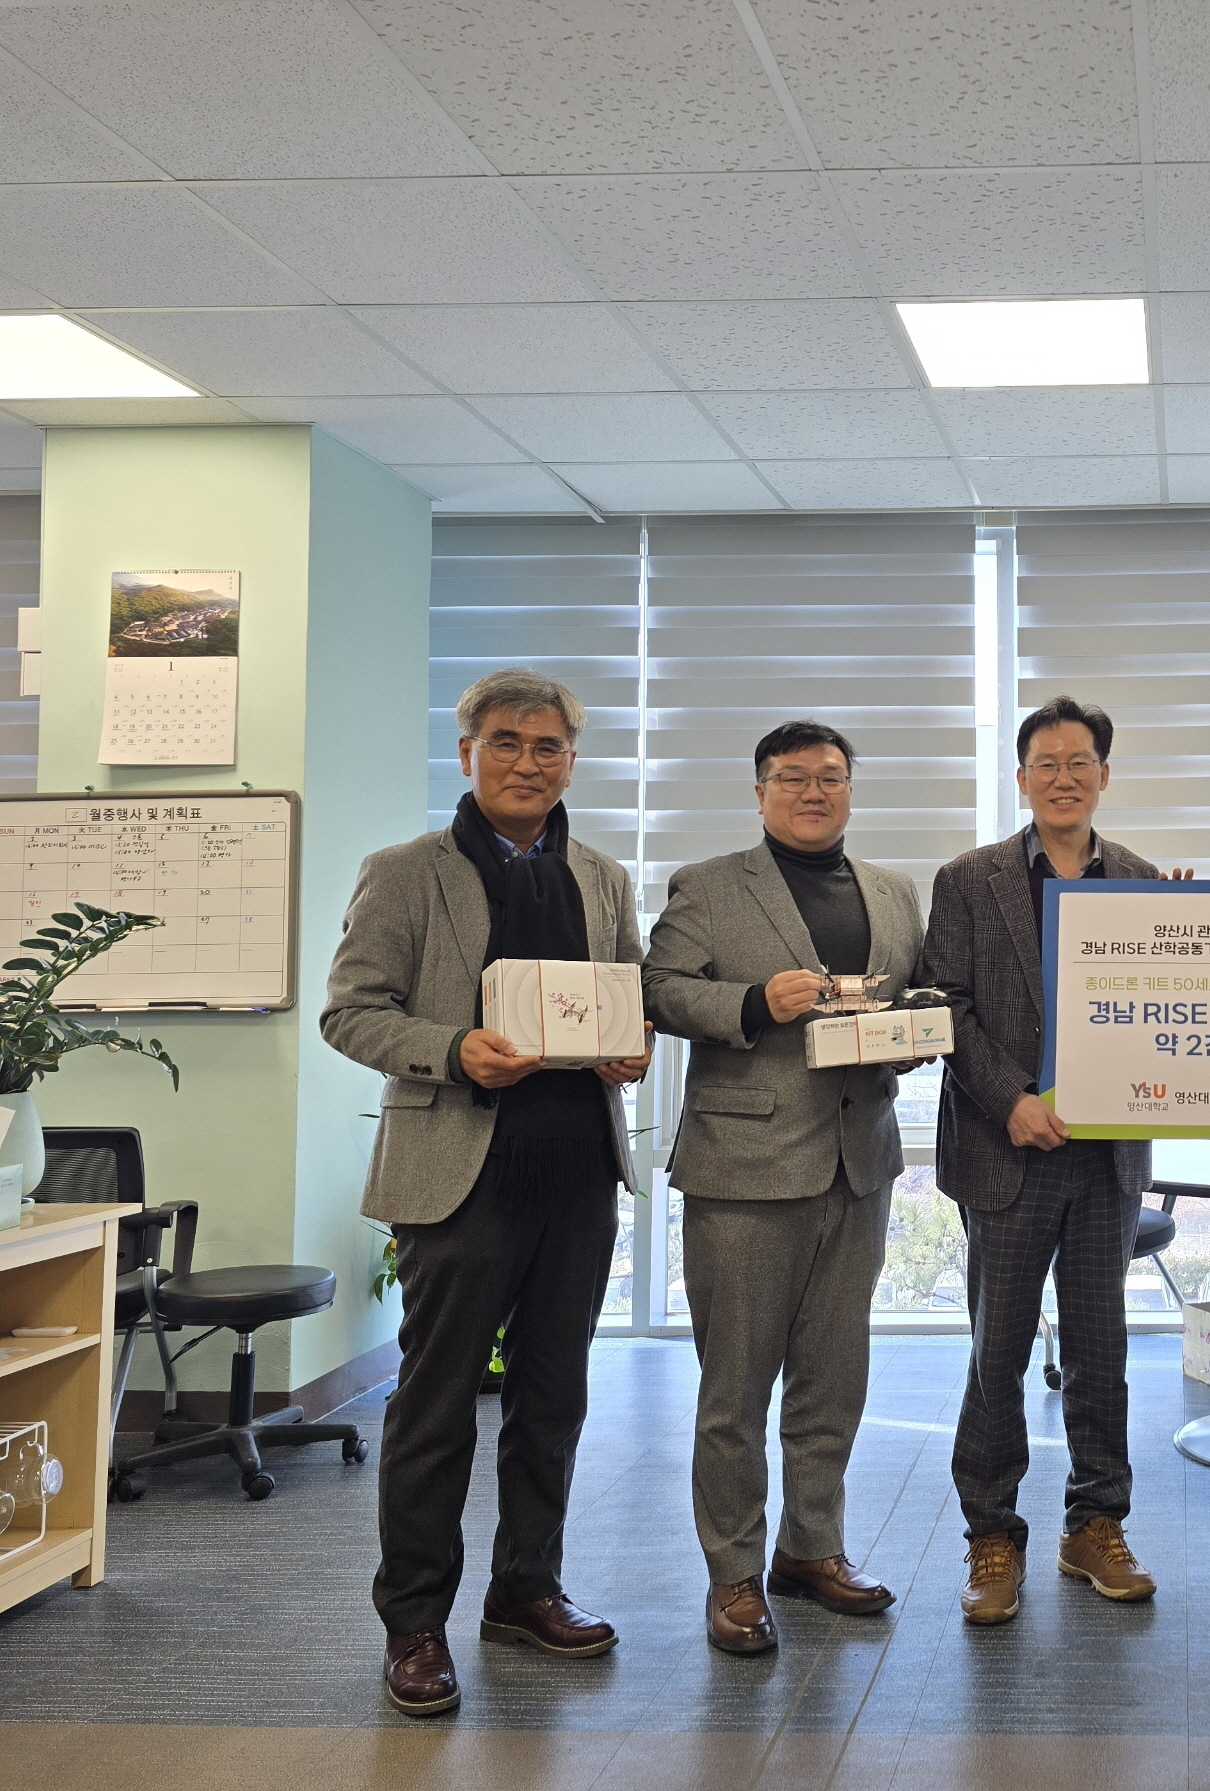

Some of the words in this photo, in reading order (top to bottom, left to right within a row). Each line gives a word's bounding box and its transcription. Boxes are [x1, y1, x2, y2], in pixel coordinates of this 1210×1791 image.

[89, 807, 142, 822] 월중행사
[147, 807, 158, 821] 및
[162, 806, 203, 820] 계획표
[1154, 925, 1193, 937] 양산시
[1081, 942, 1107, 954] 경남
[1111, 943, 1146, 954] RISE
[1085, 977, 1138, 990] 종이드론
[1143, 977, 1169, 990] 키트
[1089, 1001, 1135, 1024] 경남
[1144, 1003, 1207, 1024] RISE
[1155, 1033, 1178, 1056] 약
[1127, 1102, 1169, 1112] 영산대학교
